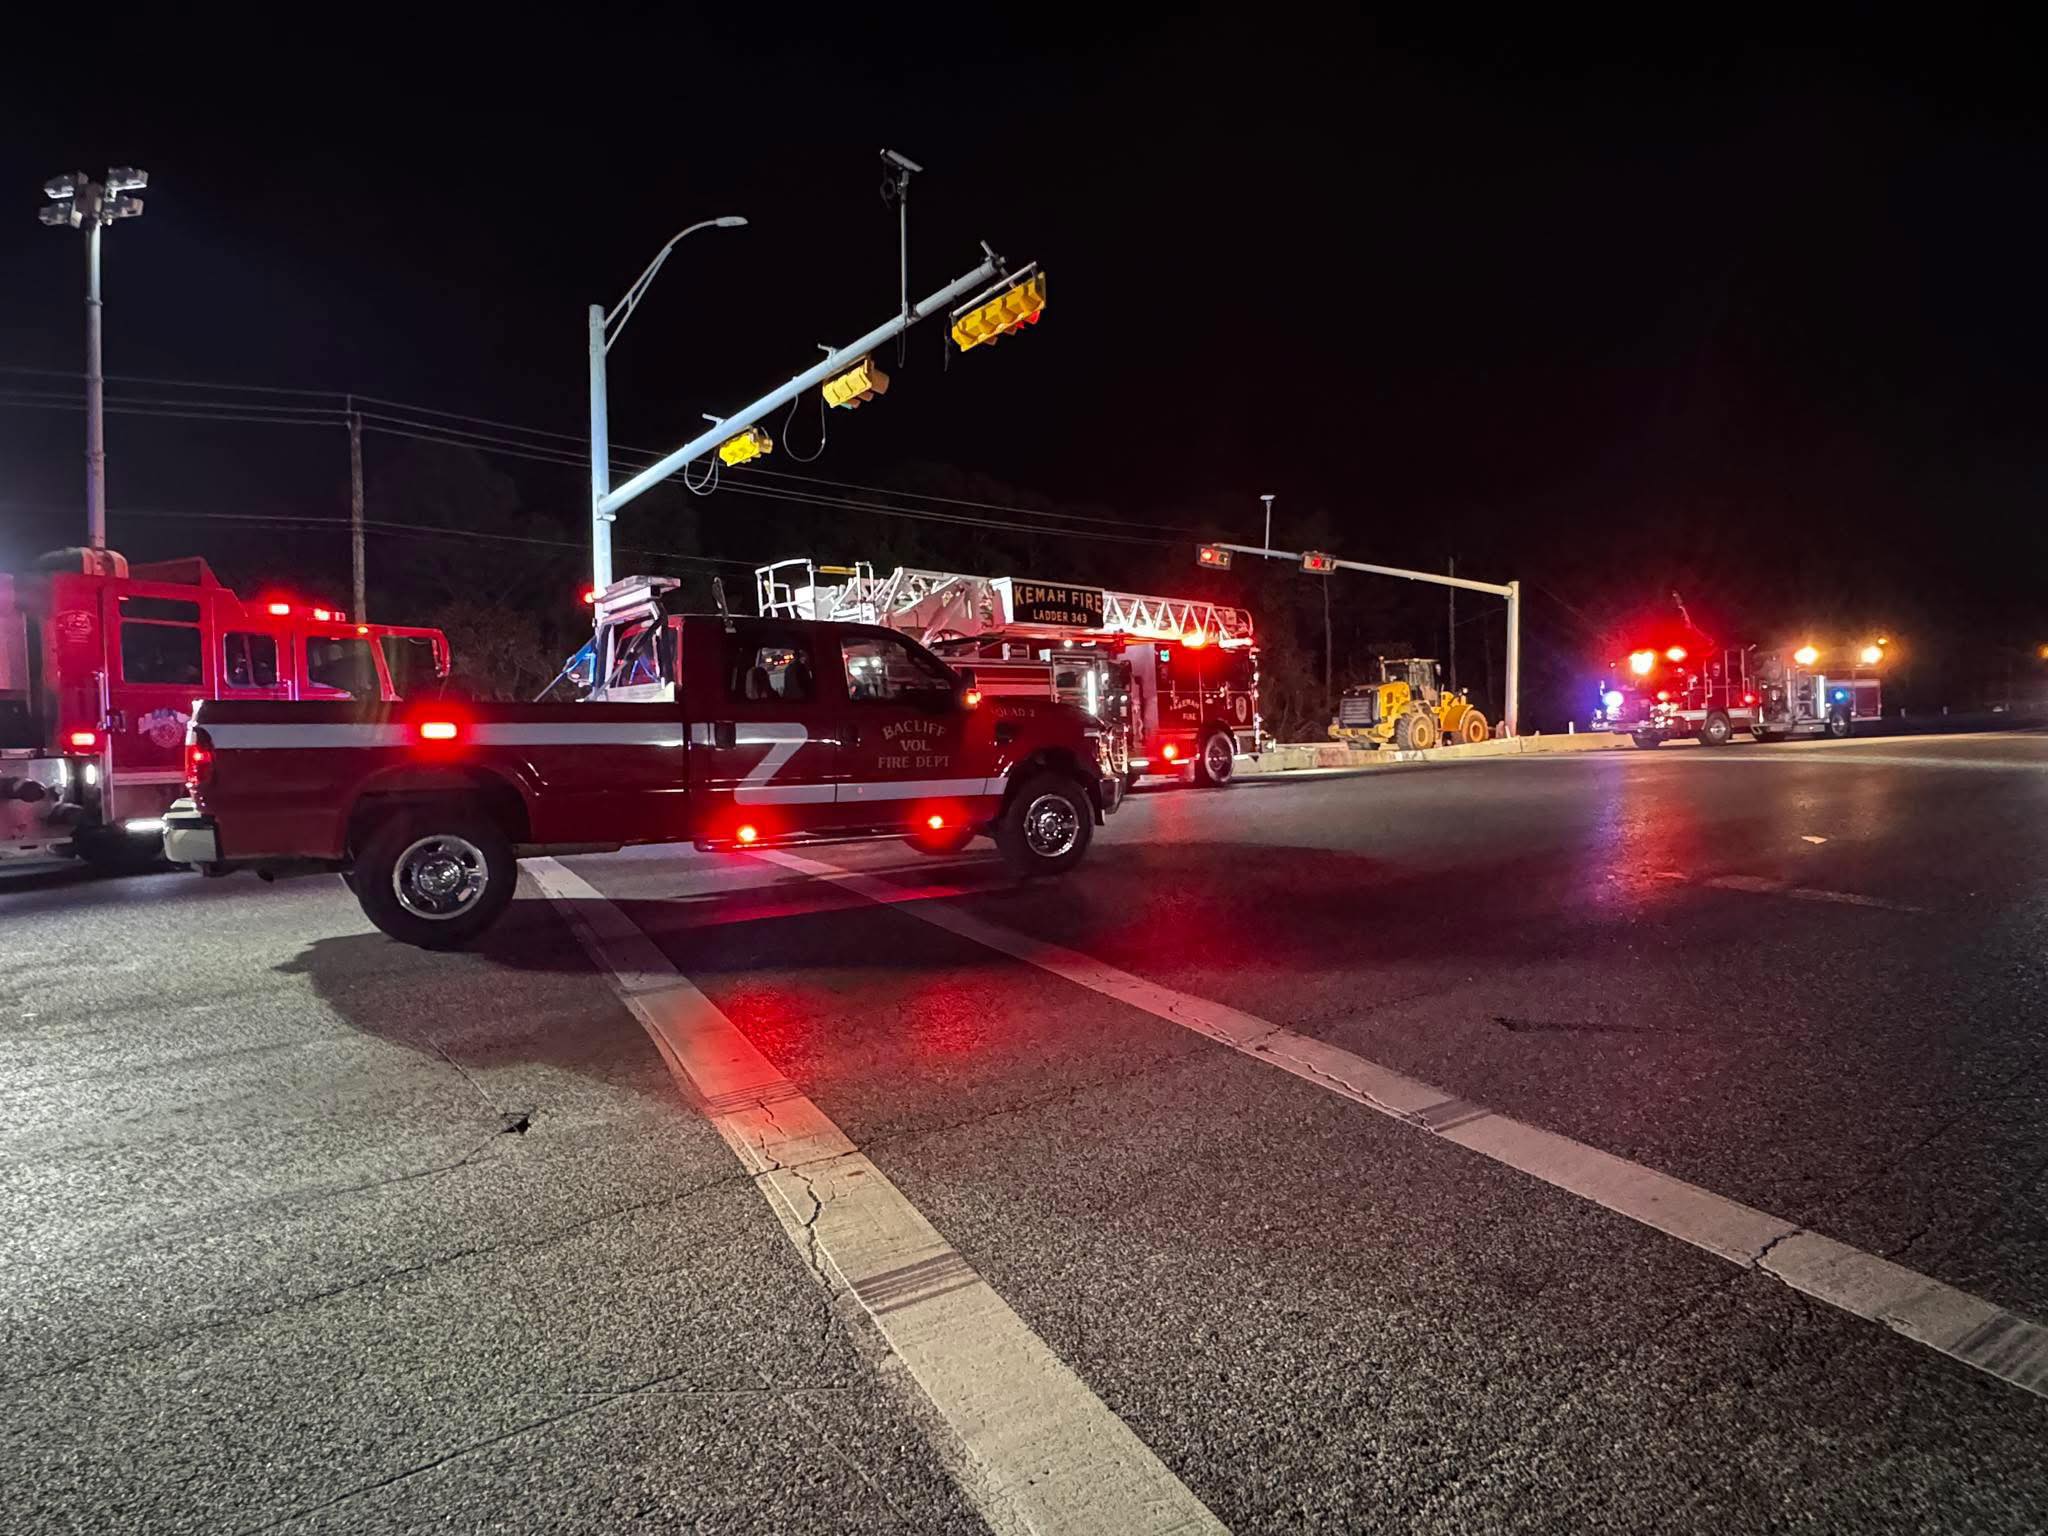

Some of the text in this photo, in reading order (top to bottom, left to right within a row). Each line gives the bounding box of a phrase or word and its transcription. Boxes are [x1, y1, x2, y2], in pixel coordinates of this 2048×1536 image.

[1014, 585, 1102, 613] KEMAH FIRE
[1033, 610, 1088, 624] LADDER 343
[882, 720, 946, 740] BACLIFF
[900, 739, 932, 751] VOL
[878, 755, 950, 769] FIRE DEPT
